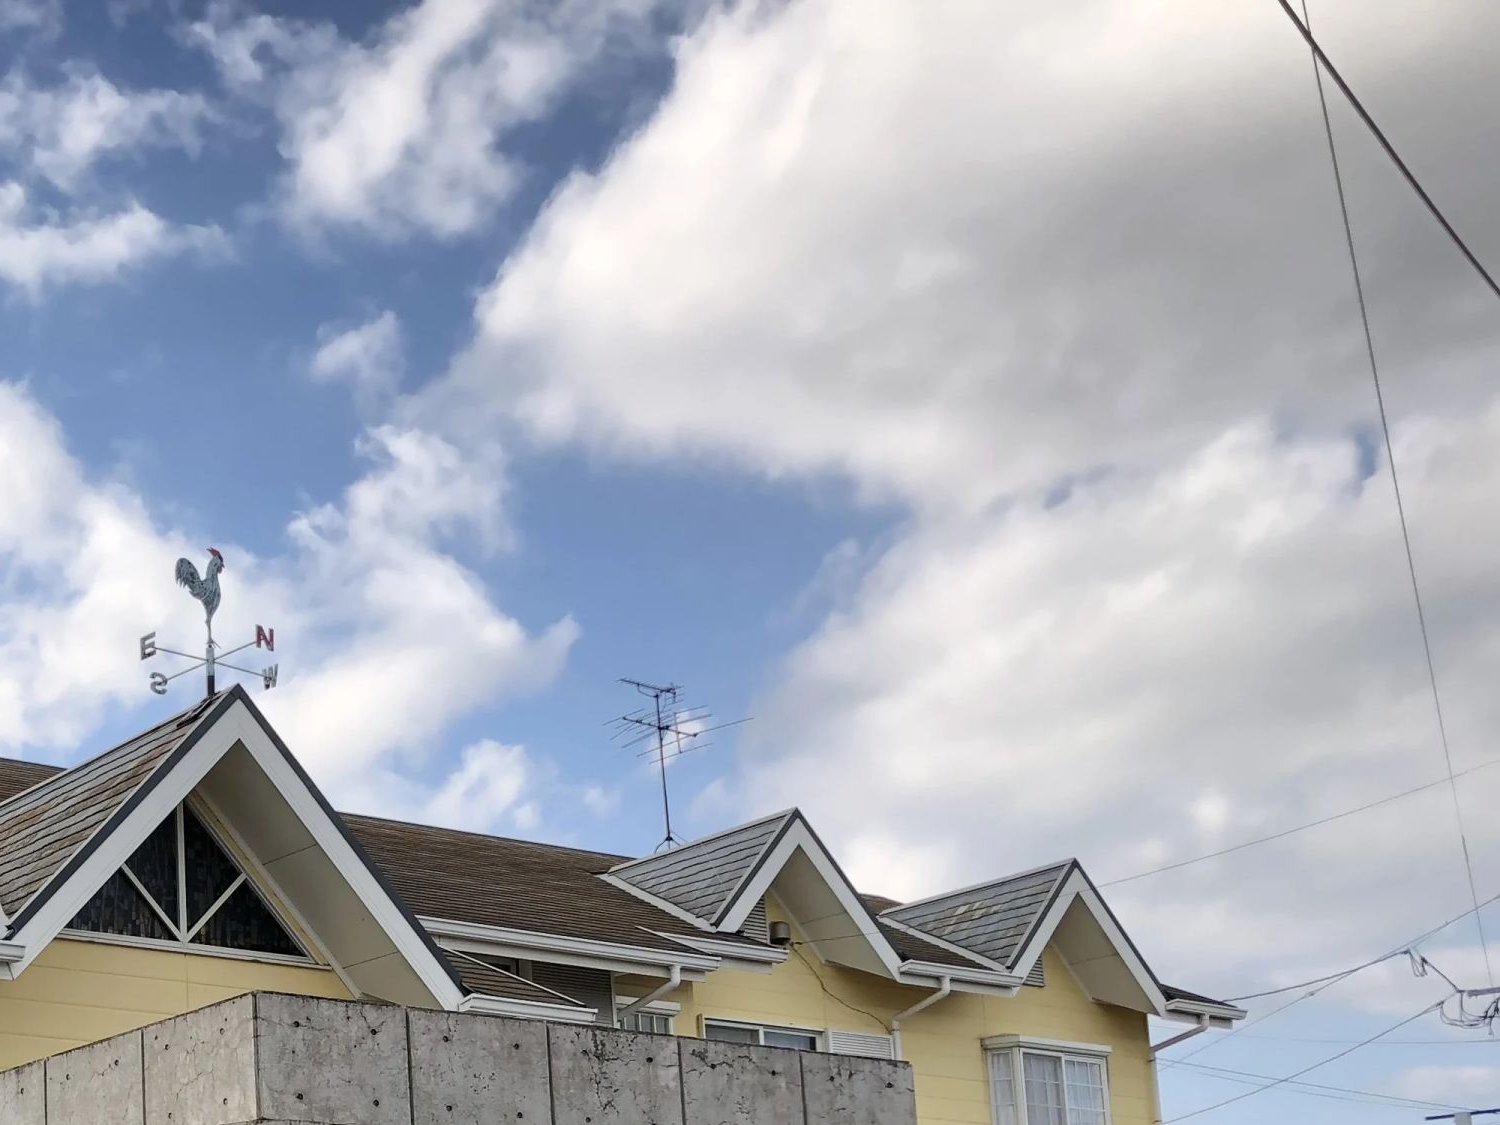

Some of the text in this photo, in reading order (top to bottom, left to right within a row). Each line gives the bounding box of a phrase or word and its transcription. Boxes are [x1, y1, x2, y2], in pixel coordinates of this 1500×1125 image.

[140, 631, 156, 660] E
[256, 624, 274, 652] N
[262, 664, 278, 690] W
